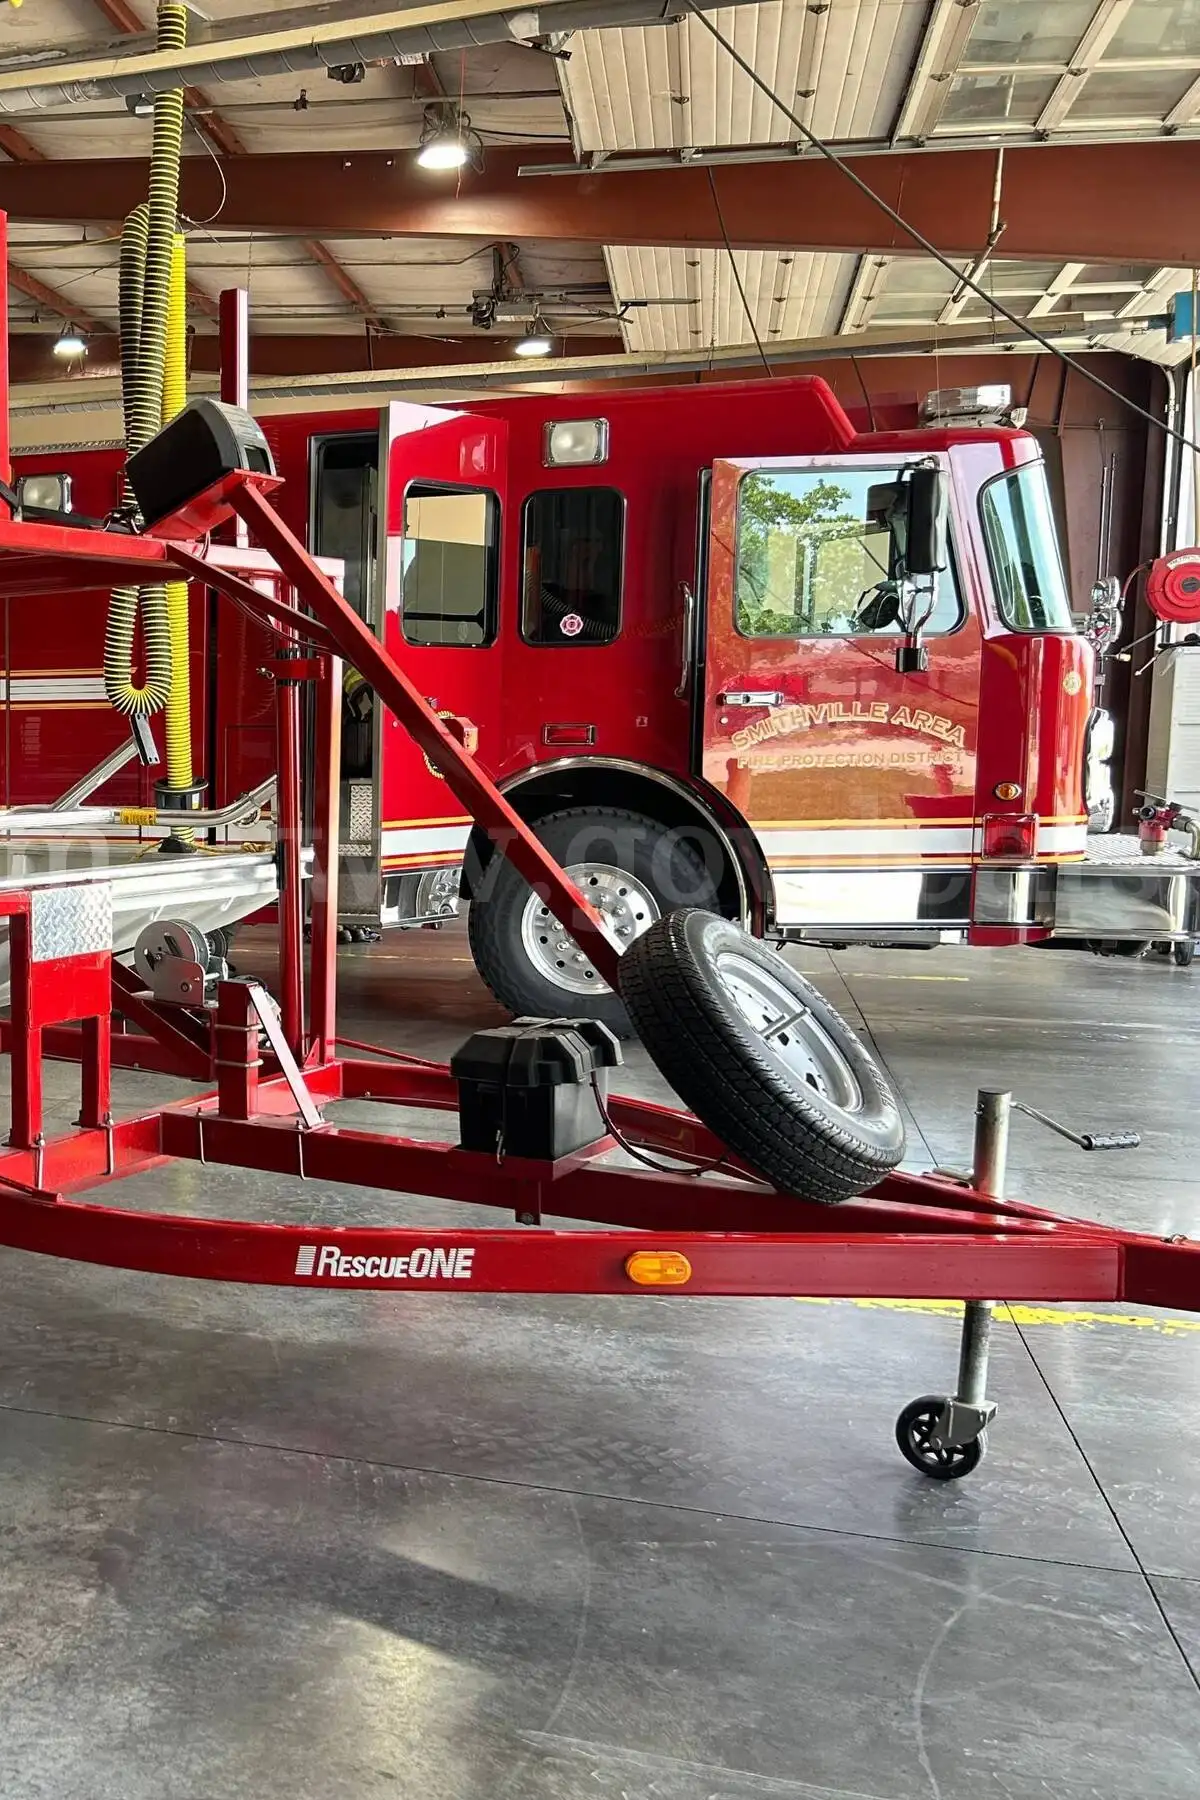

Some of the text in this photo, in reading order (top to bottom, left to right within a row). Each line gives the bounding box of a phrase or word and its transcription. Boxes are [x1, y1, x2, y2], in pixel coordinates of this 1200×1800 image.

[731, 701, 965, 751] SMITHVILLE AREA
[737, 750, 964, 769] FIRE PROTECTION DISTRICT
